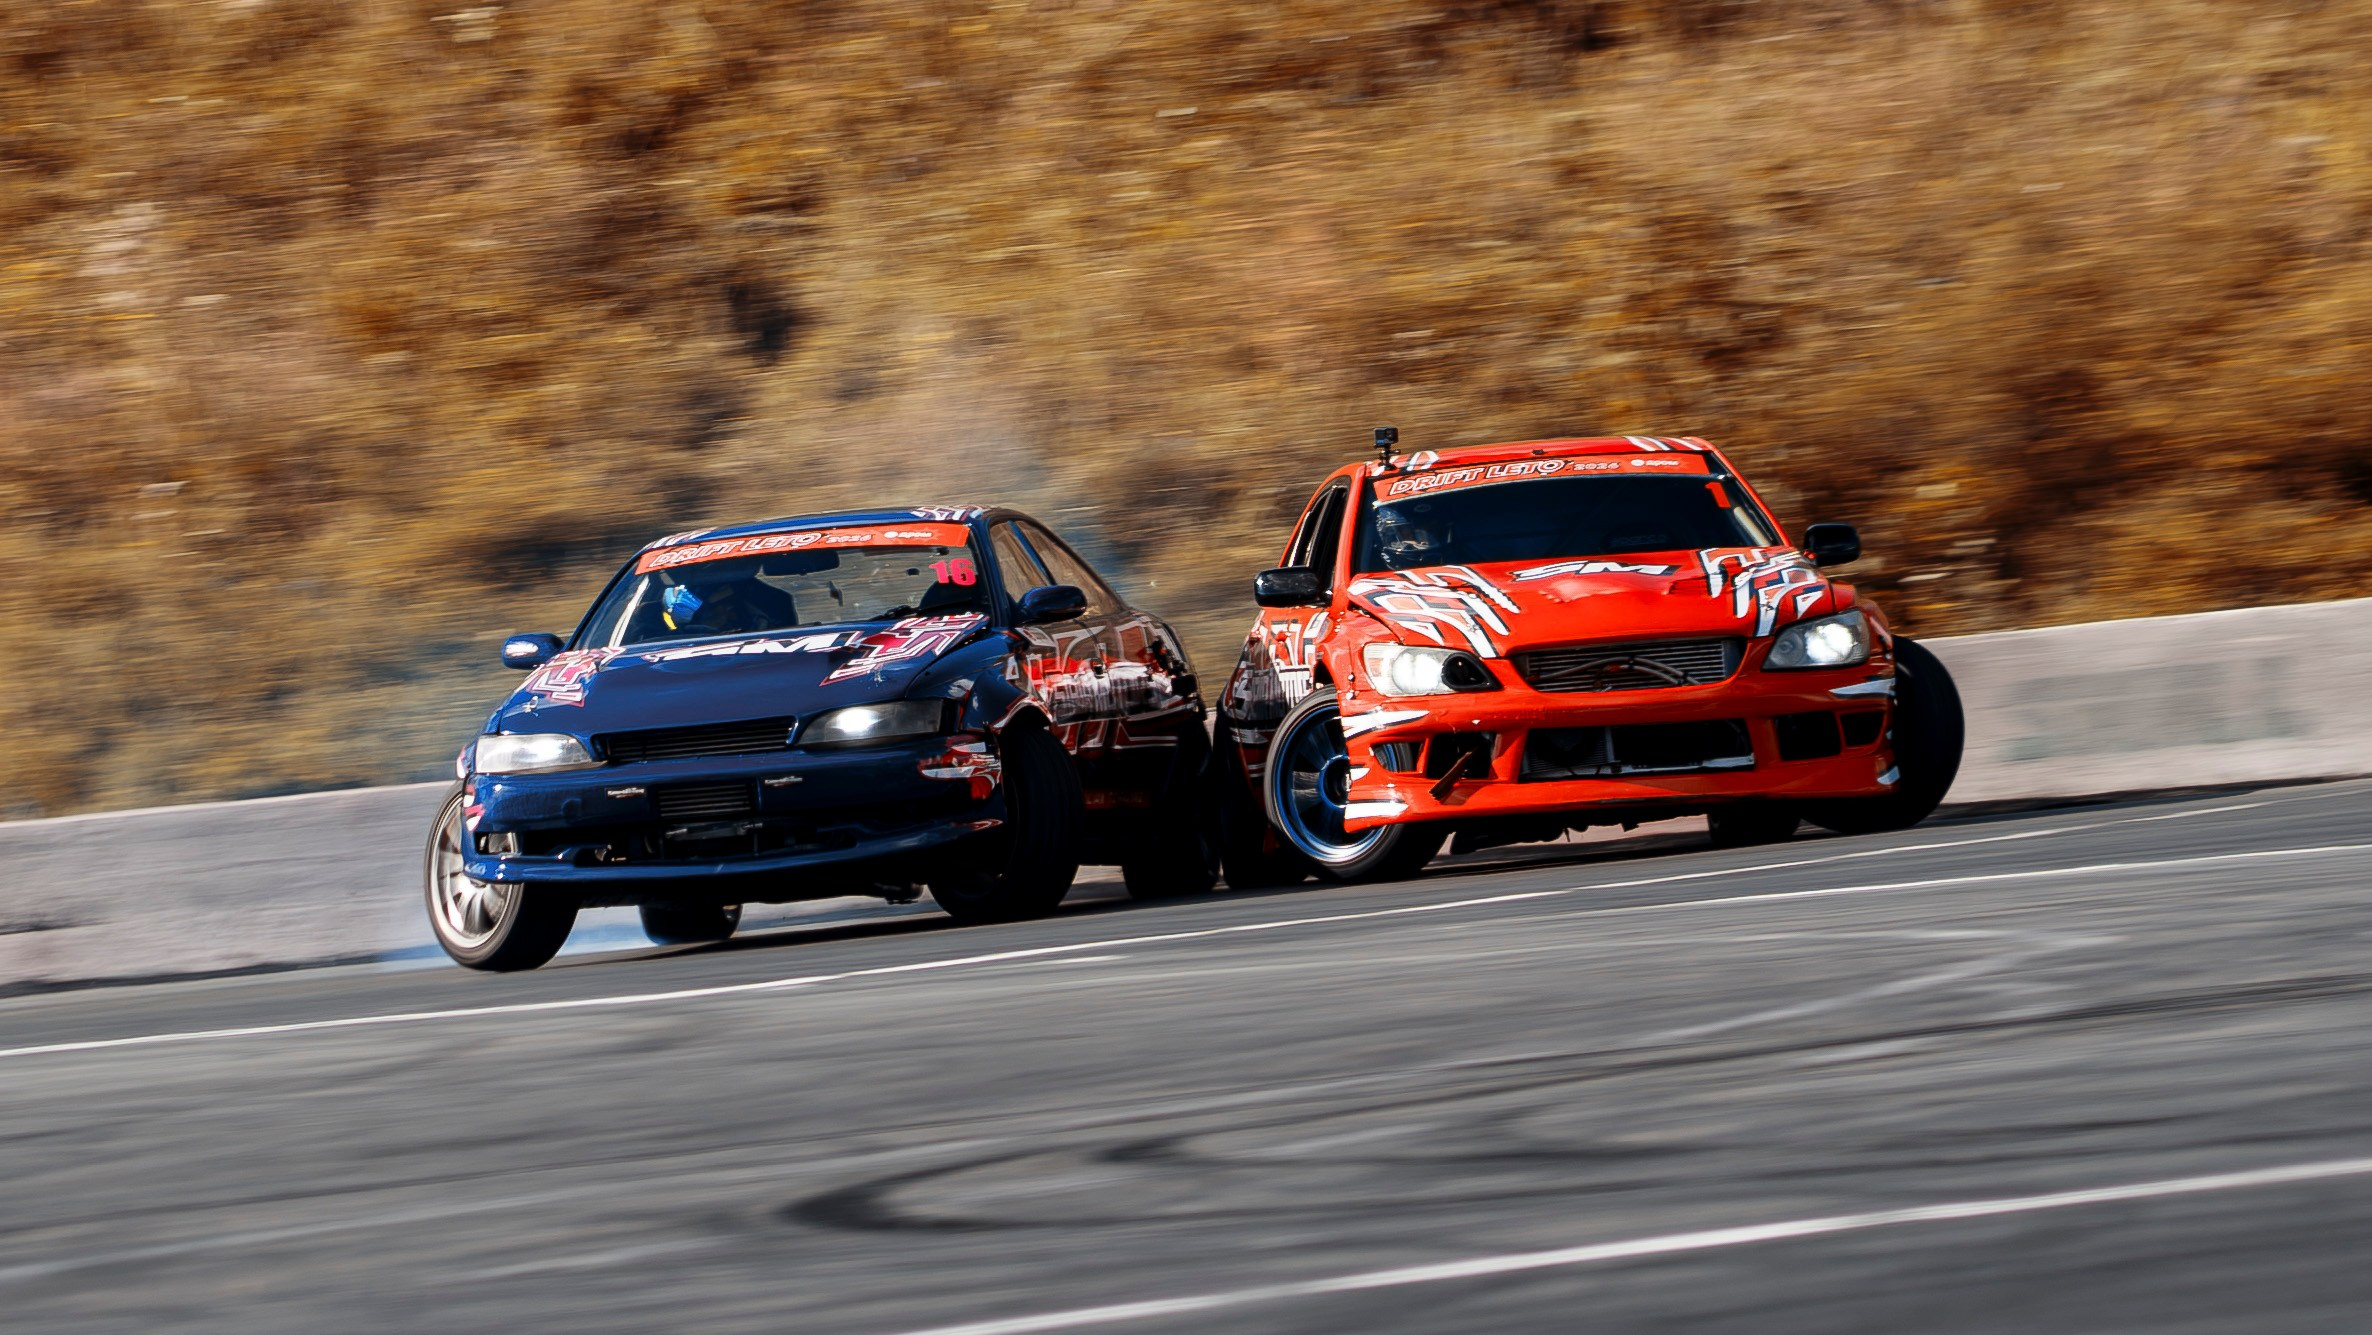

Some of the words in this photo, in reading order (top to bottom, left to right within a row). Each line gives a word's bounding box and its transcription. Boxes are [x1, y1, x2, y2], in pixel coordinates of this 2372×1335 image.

[1389, 467, 1484, 495] DRIFT
[1486, 459, 1566, 479] LETO
[1704, 481, 1731, 509] 1
[649, 540, 744, 568] DRIFT
[740, 532, 822, 552] LETO
[928, 558, 977, 586] 16
